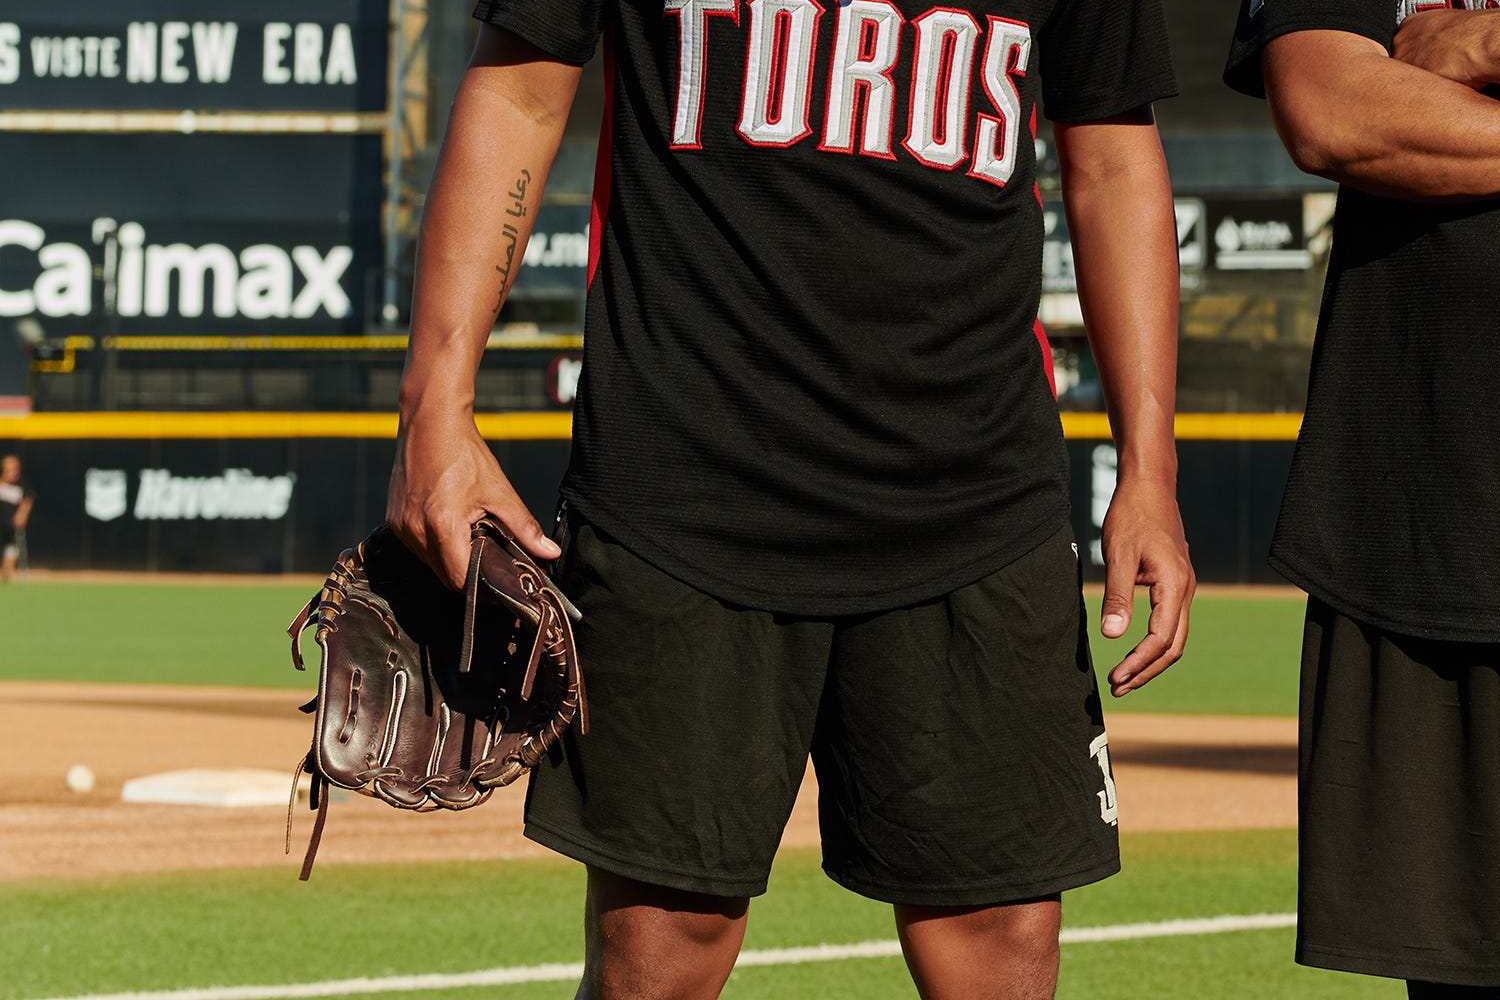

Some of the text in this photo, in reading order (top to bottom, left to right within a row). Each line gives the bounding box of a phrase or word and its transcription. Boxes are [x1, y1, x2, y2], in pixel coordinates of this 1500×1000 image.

[30, 36, 122, 79] VISTE
[126, 21, 239, 85] NEW
[262, 21, 358, 85] ERA
